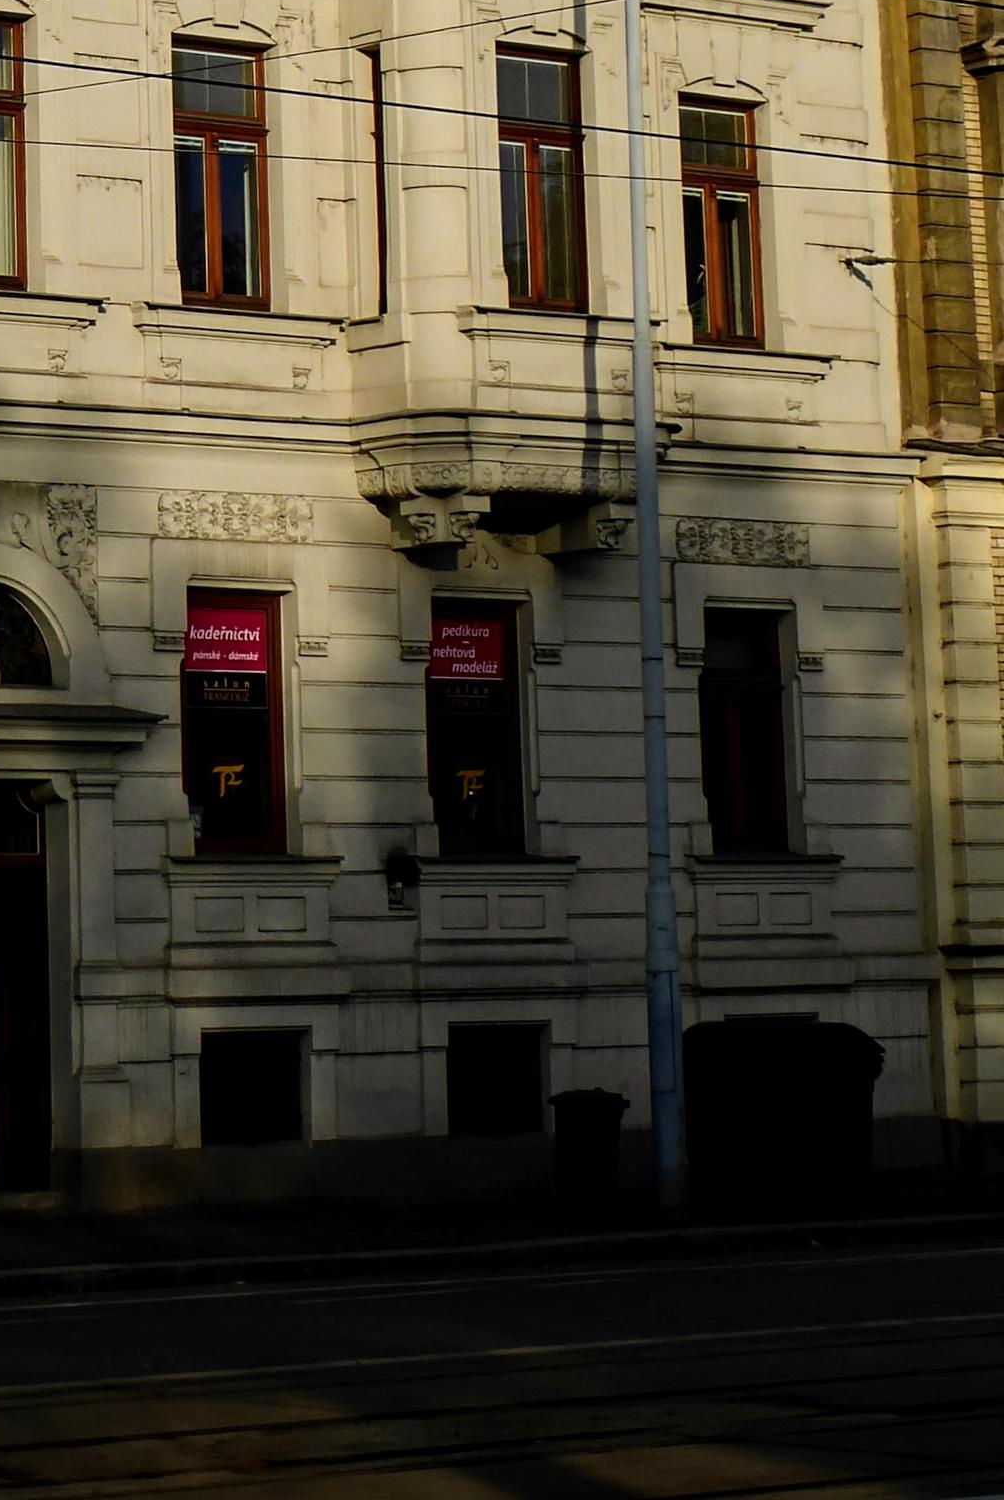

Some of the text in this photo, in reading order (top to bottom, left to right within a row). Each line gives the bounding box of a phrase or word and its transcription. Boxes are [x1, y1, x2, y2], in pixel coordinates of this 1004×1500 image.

[189, 624, 261, 642] kadeřnictví
[442, 624, 490, 640] pedikúra
[193, 650, 221, 661] pánské
[228, 650, 259, 661] dámské
[433, 644, 476, 659] nehtová
[452, 660, 499, 674] modeláž
[203, 676, 250, 688] salon
